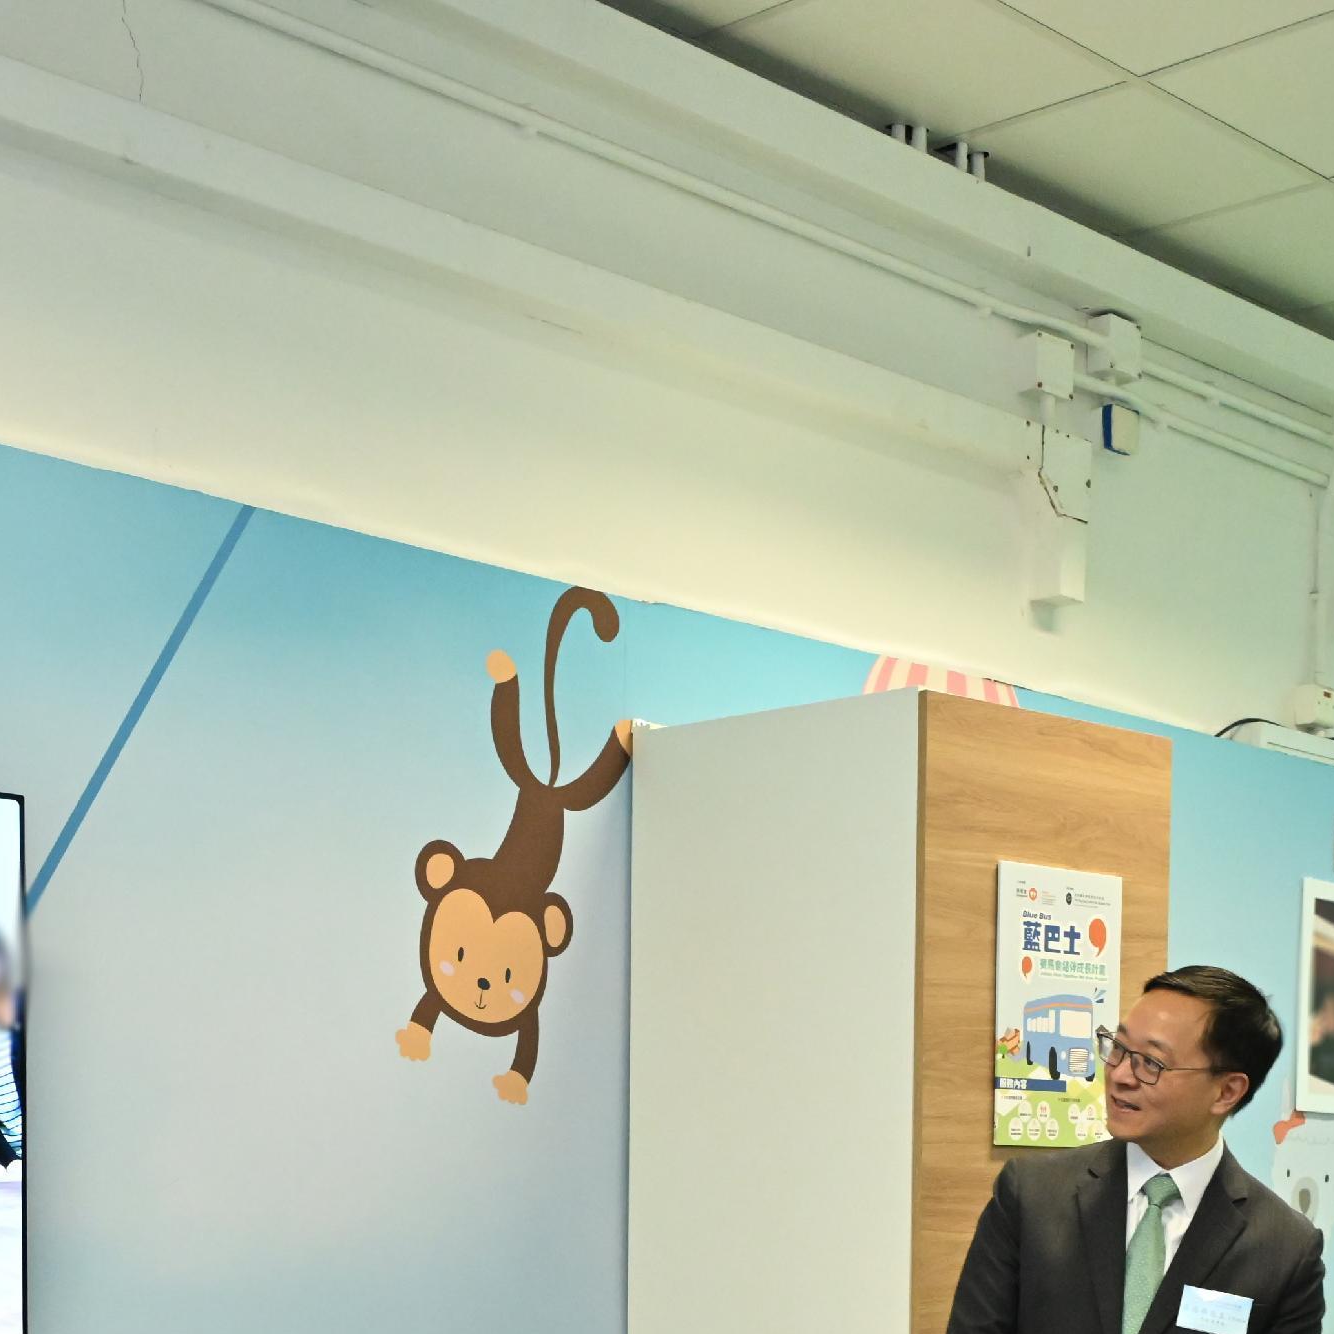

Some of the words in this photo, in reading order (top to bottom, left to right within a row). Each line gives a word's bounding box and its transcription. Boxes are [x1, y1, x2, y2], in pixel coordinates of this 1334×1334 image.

[1022, 910, 1038, 918] Blue
[1039, 912, 1052, 920] Bus
[1022, 920, 1081, 956] 藍巴士
